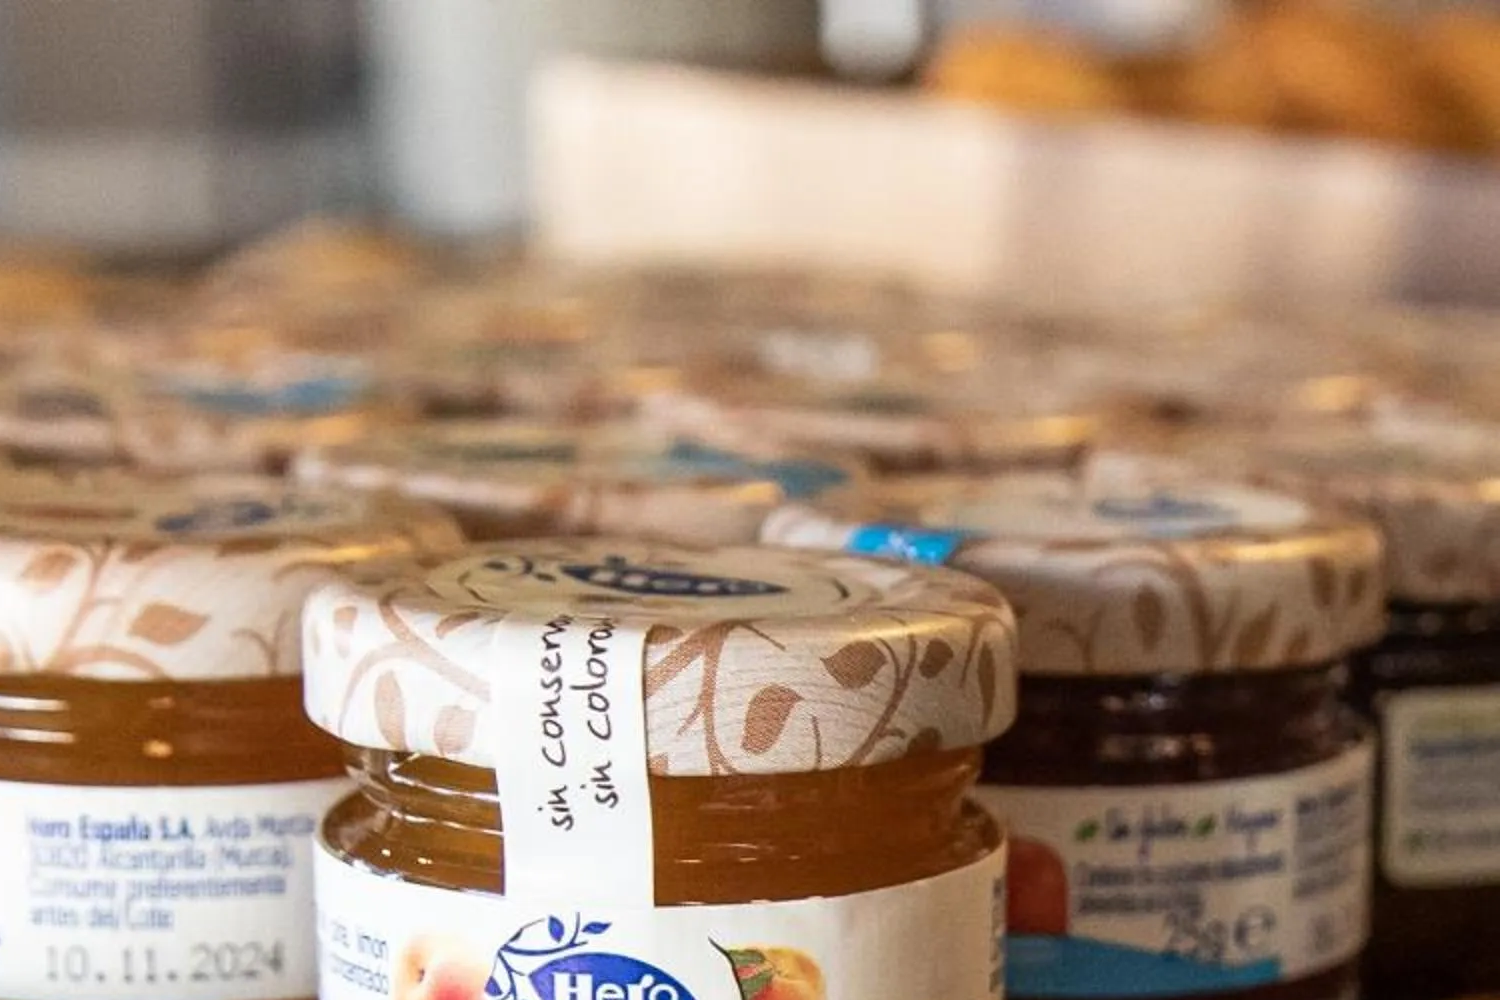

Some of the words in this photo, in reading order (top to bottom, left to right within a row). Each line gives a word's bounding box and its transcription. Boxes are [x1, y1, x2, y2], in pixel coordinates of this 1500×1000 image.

[537, 784, 575, 832] sin
[580, 760, 619, 809] sin
[46, 938, 284, 985] 10.11.2024
